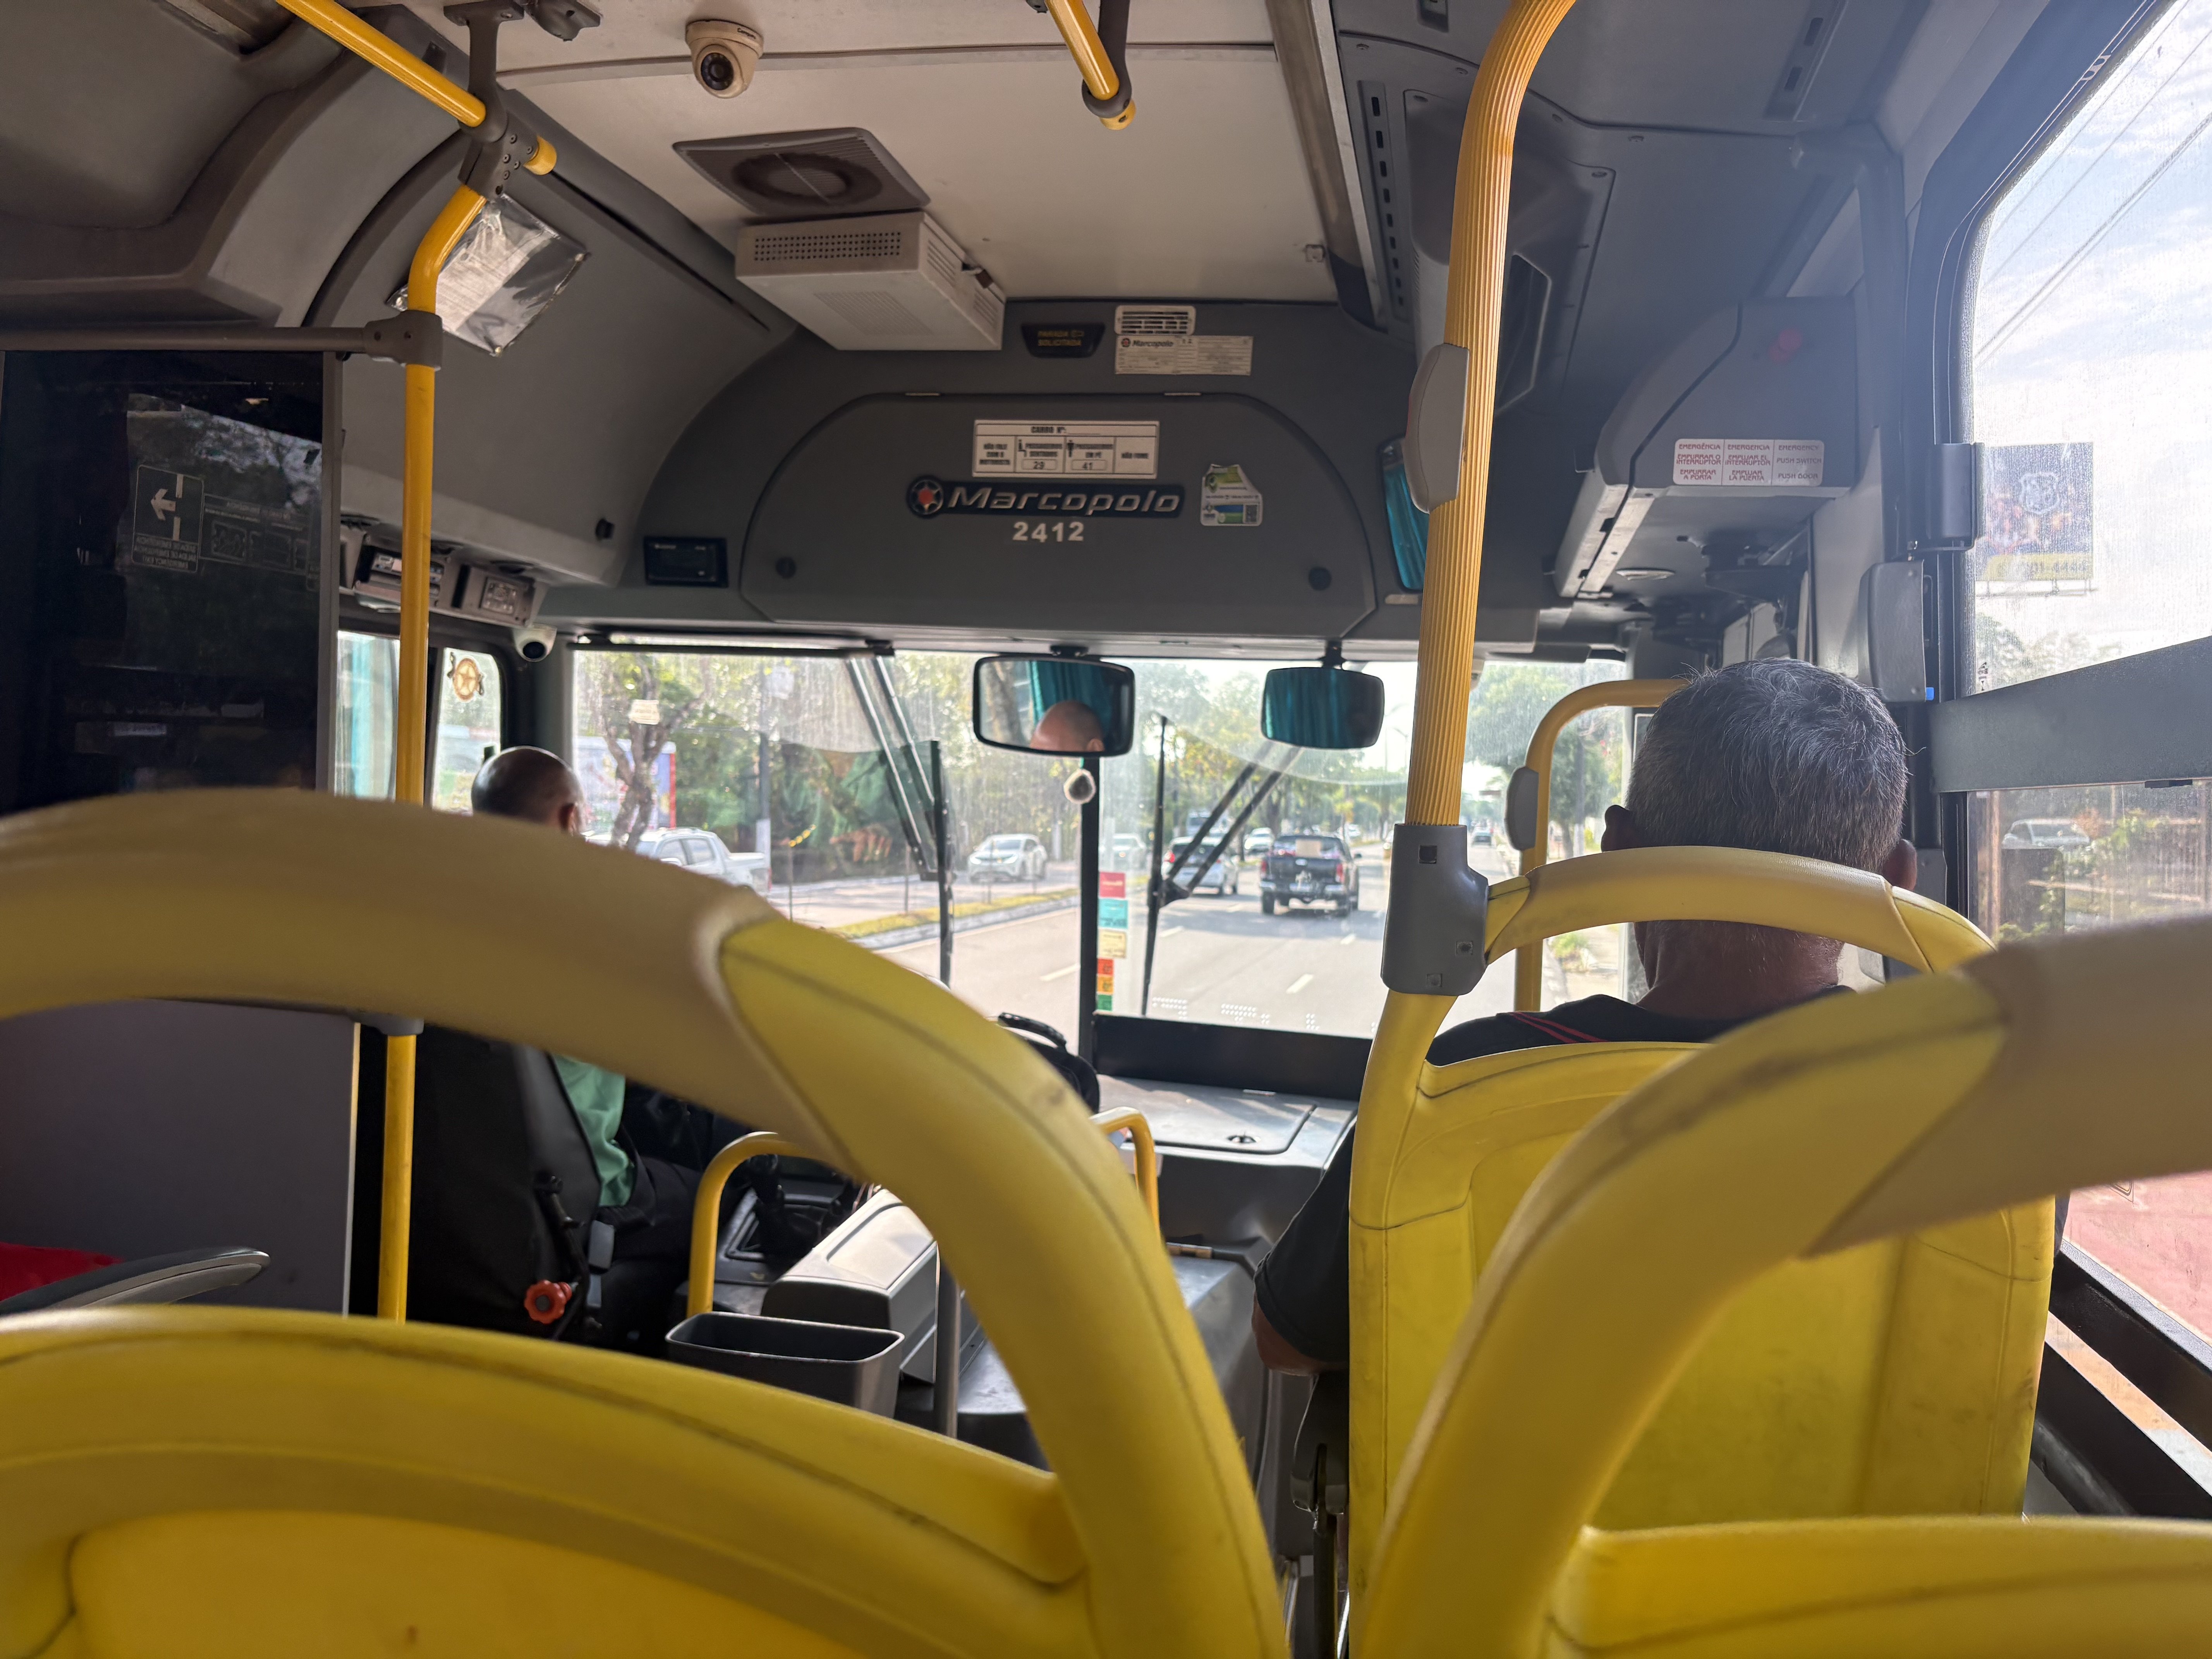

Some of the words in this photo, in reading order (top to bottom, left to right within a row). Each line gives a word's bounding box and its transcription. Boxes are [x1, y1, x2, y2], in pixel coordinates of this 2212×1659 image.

[1033, 461, 1044, 469] 29
[1082, 462, 1093, 470] 41
[948, 487, 1181, 515] Marcopolo
[1012, 522, 1084, 542] 2412
